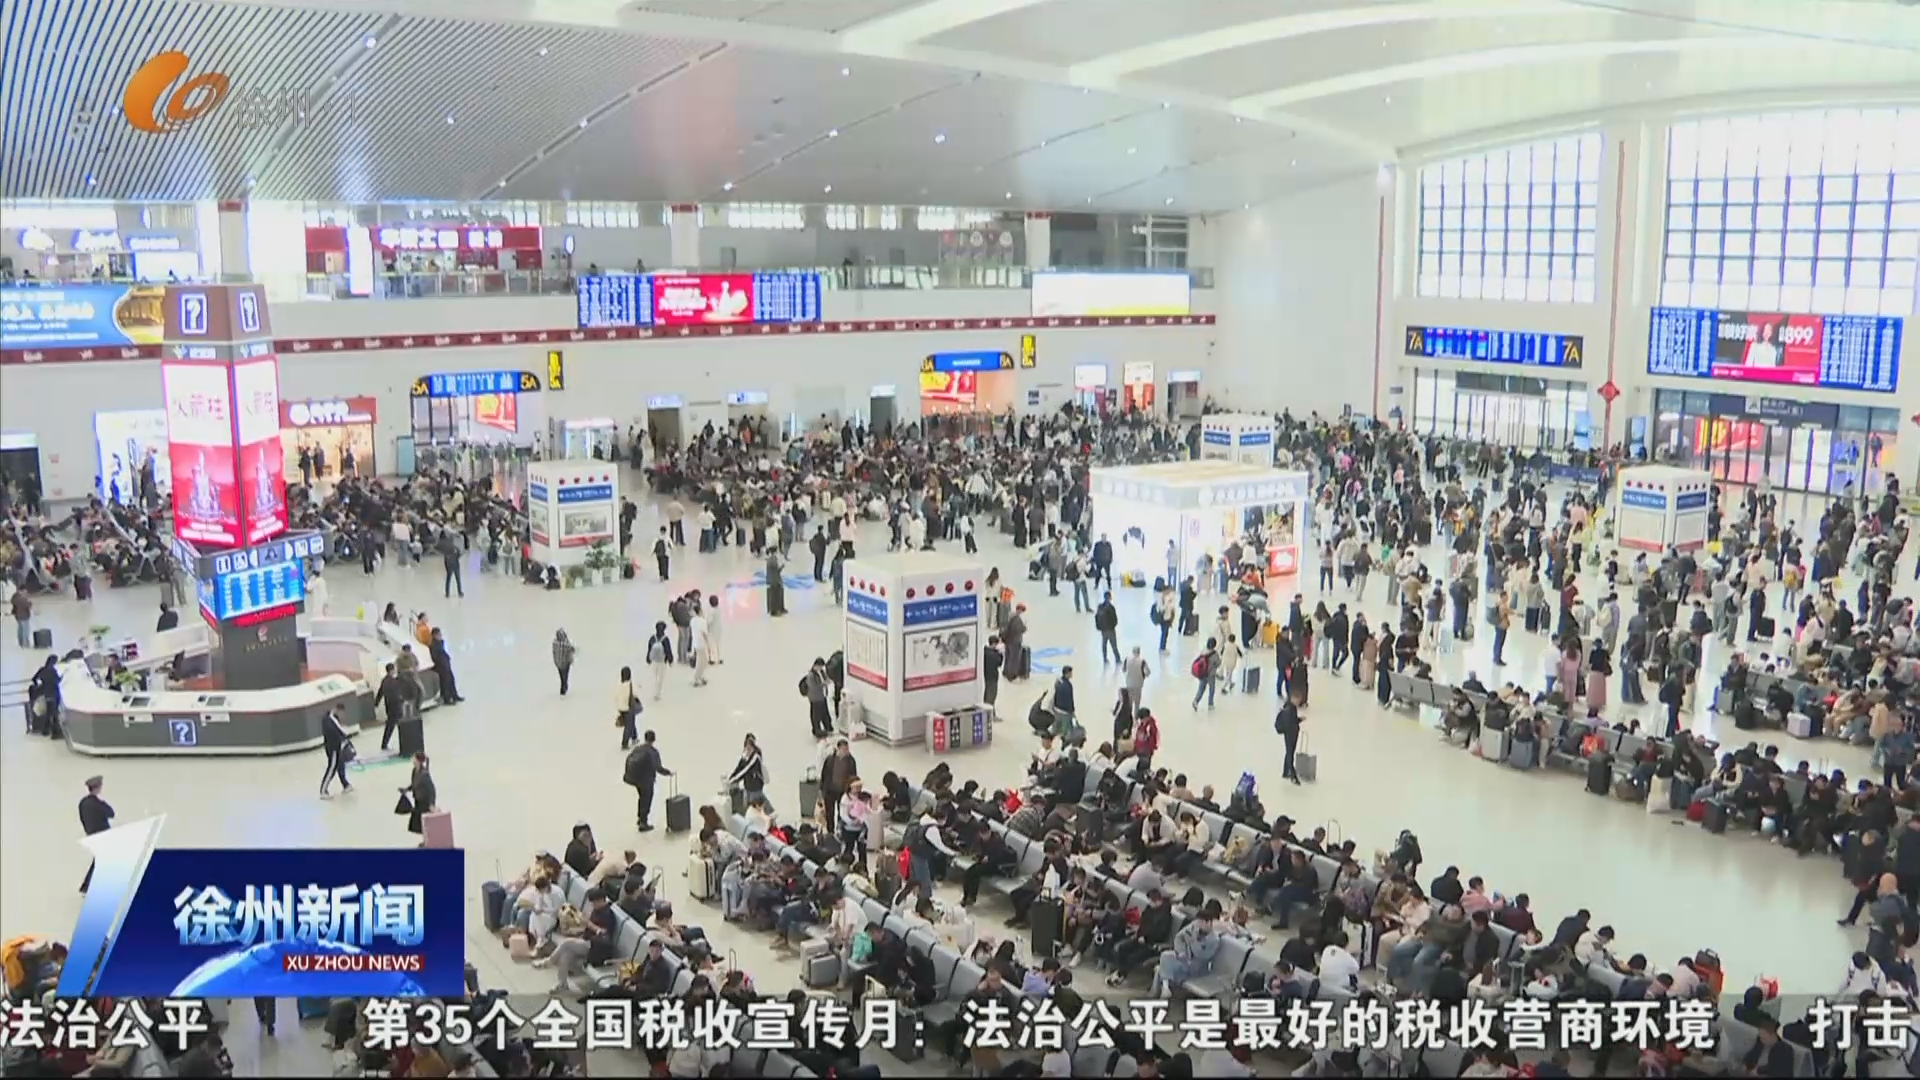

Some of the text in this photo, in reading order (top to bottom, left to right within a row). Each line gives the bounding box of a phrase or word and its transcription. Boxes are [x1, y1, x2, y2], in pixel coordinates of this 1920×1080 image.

[1409, 331, 1423, 351] 7A
[1562, 341, 1580, 363] 7A
[412, 379, 429, 396] 5A
[521, 374, 538, 390] 5A
